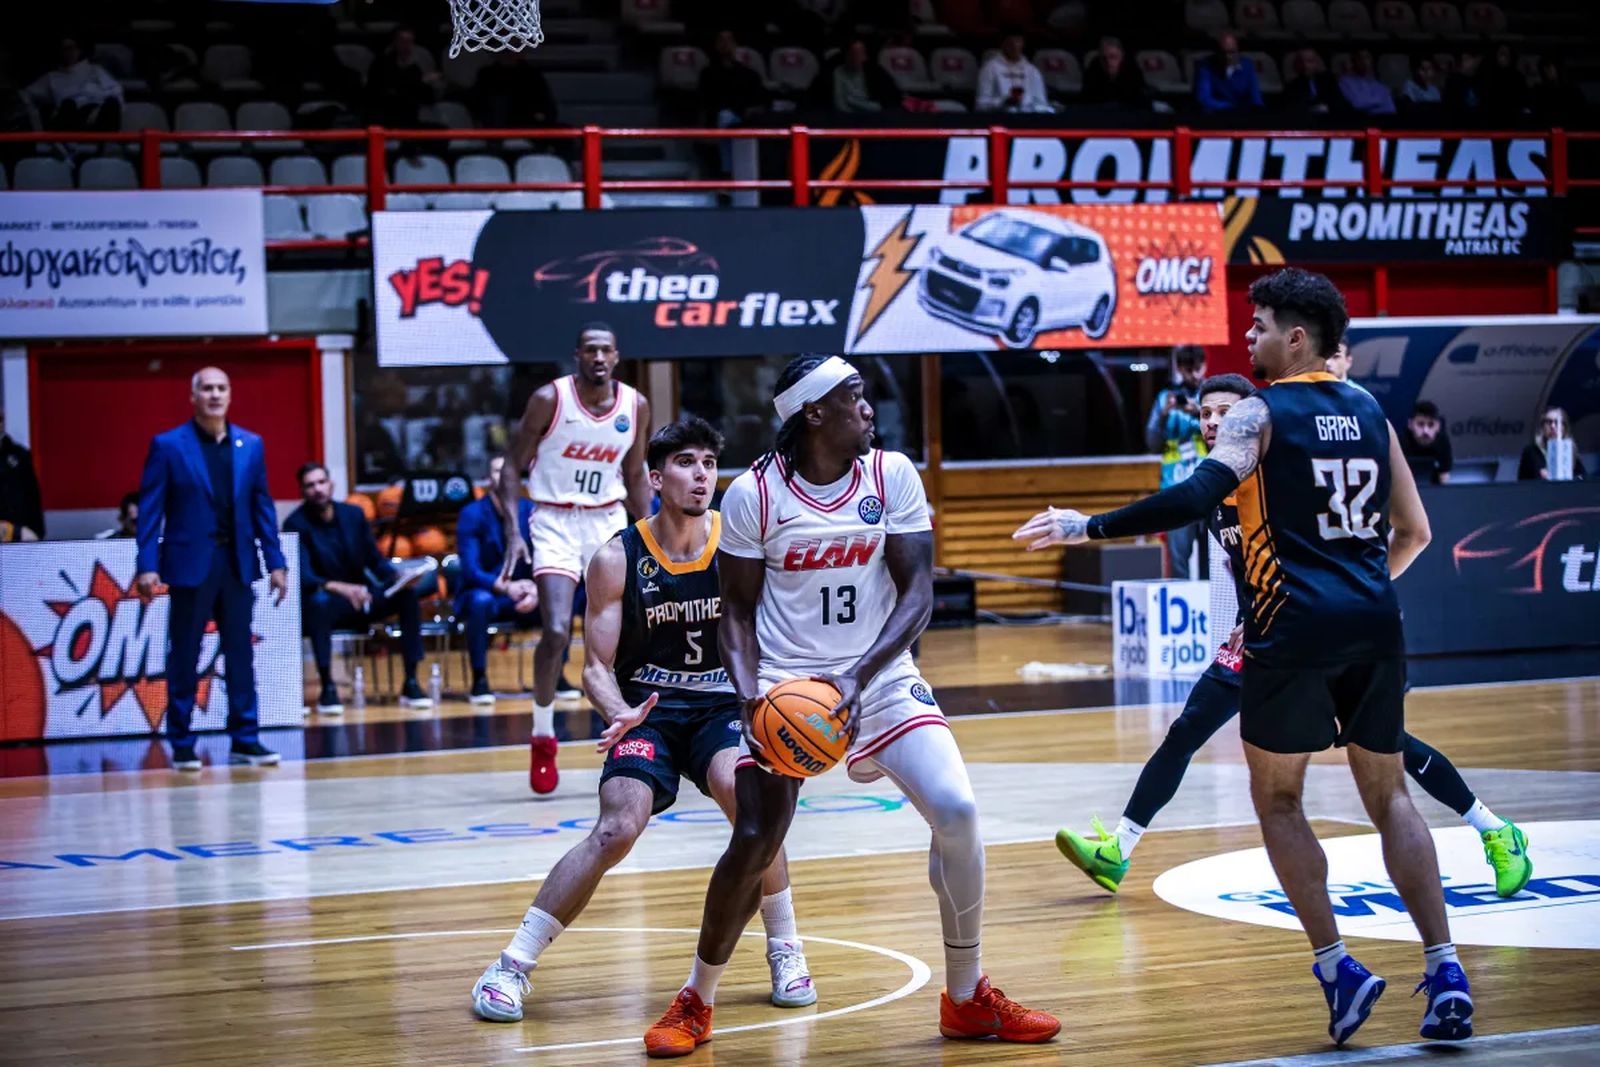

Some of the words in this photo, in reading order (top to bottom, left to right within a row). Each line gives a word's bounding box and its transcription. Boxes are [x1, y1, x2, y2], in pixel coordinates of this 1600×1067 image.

[1288, 202, 1530, 241] PROMITHEAS
[1445, 239, 1499, 256] PATRAS
[389, 256, 490, 319] YES!
[605, 267, 720, 302] theo
[1135, 255, 1212, 295] OMG!
[1315, 415, 1361, 441] GRAY
[561, 442, 624, 464] ELAN
[574, 469, 602, 494] 40
[1311, 458, 1381, 540] 32
[783, 533, 882, 571] ELAN
[819, 584, 857, 626] 13
[684, 630, 703, 665] 5
[1171, 639, 1206, 669] job
[618, 741, 650, 752] VIKOS
[618, 748, 648, 758] COLA
[776, 725, 827, 772] Wilson
